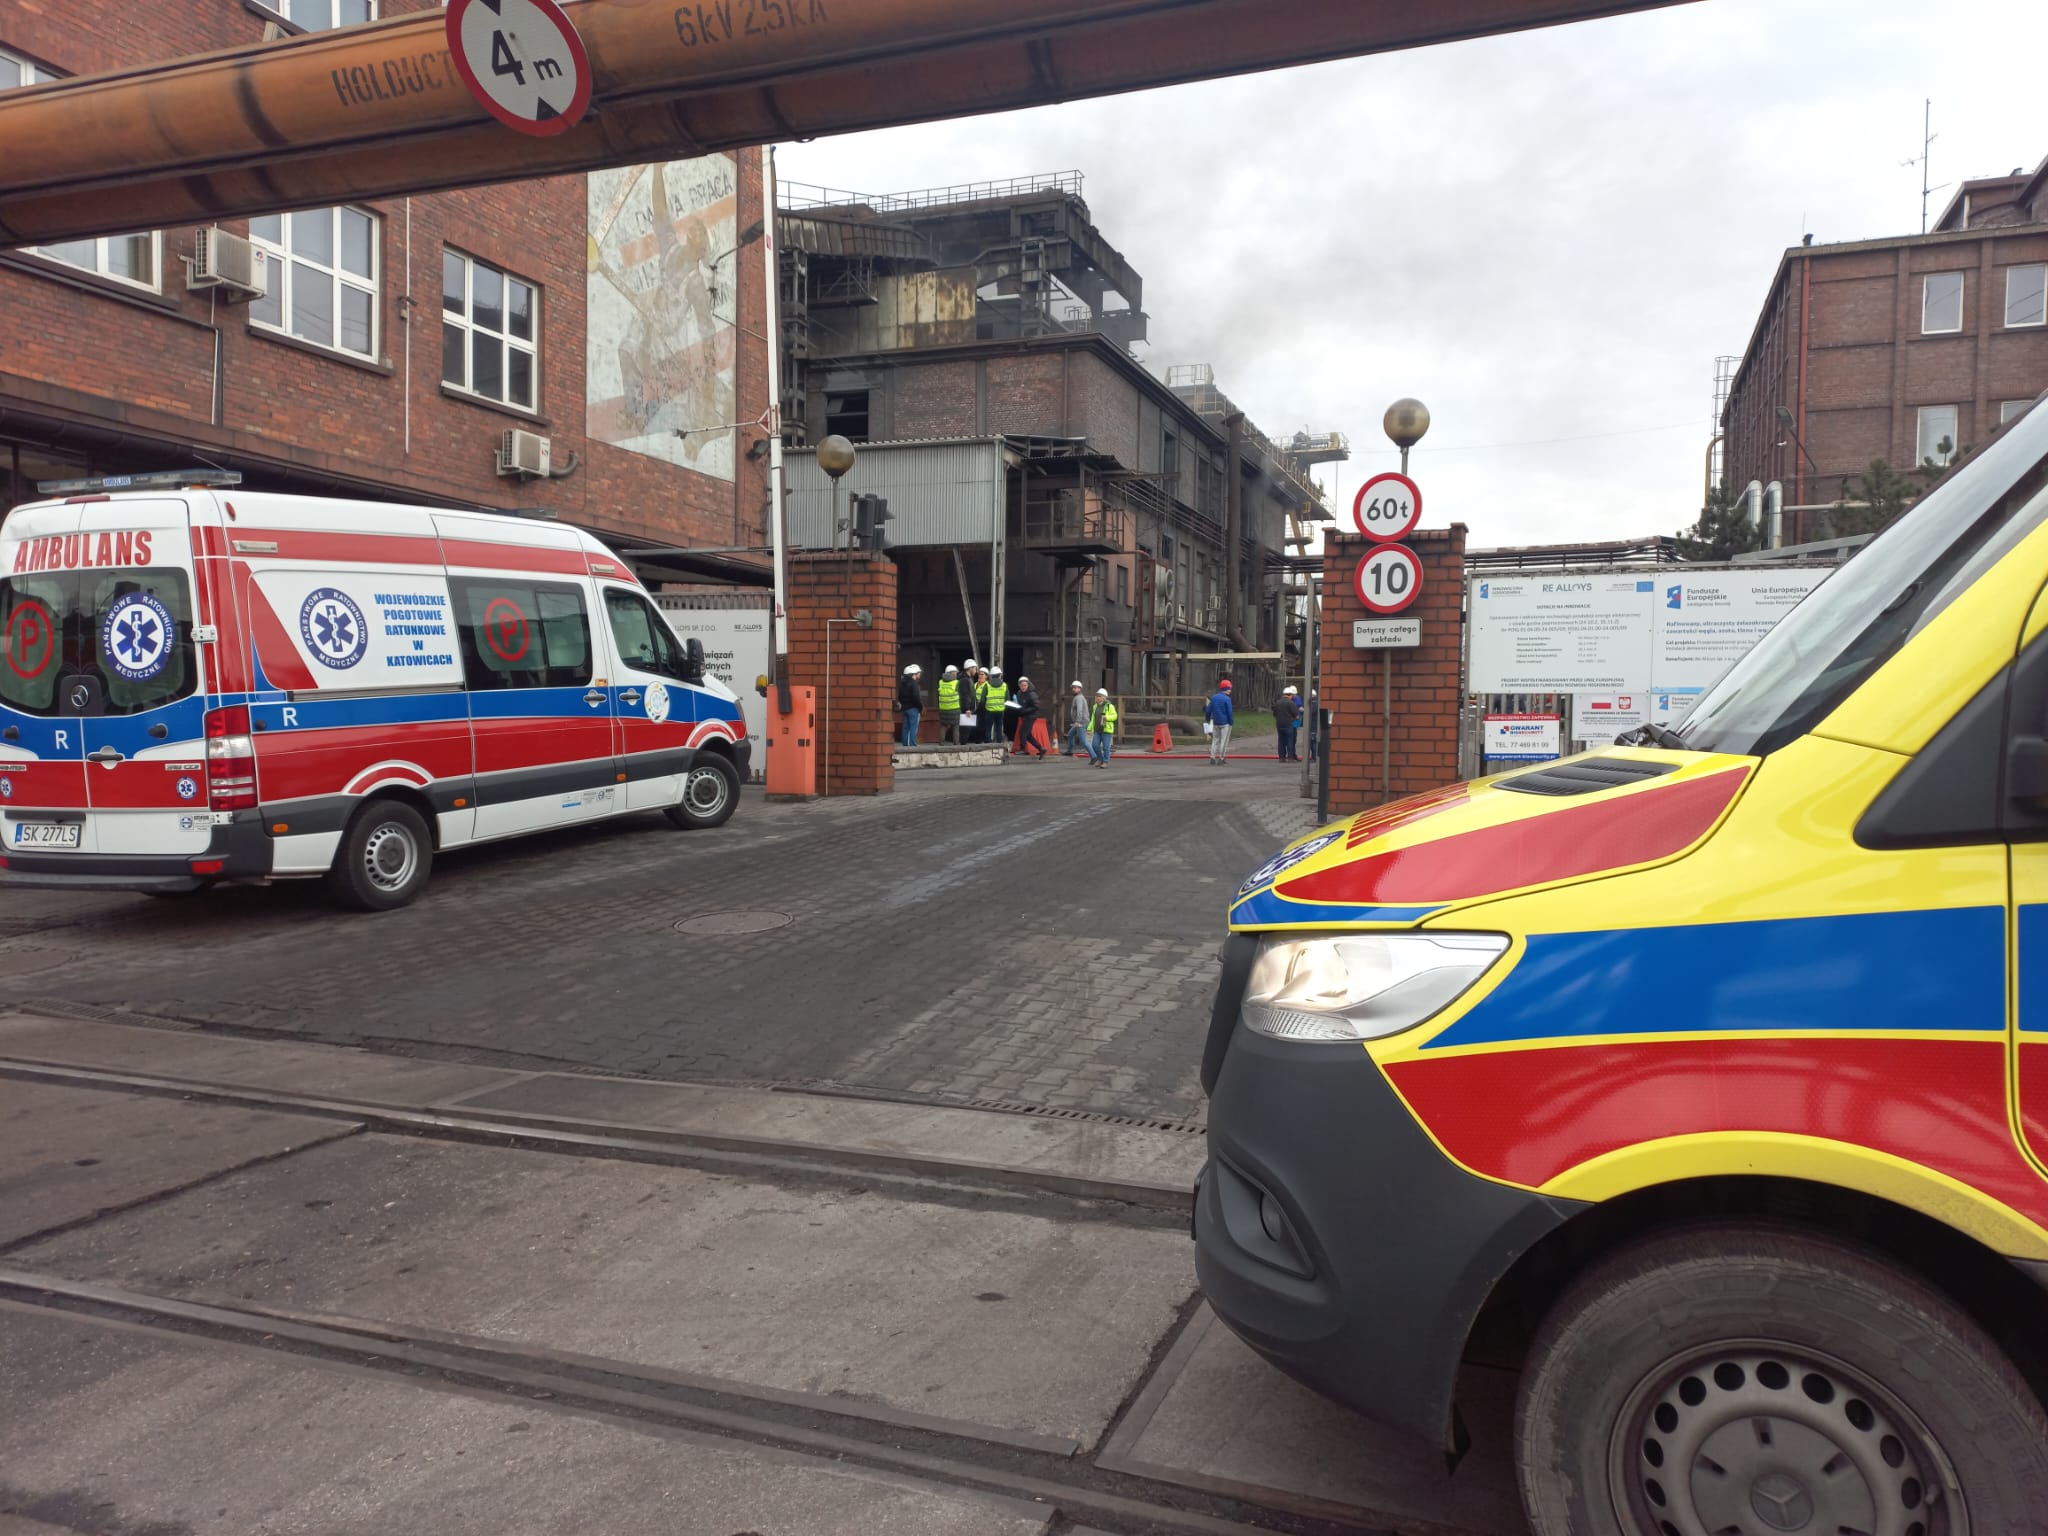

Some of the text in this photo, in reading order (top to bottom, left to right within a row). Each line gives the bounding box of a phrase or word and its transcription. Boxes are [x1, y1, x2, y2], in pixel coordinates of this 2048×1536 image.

[491, 28, 563, 86] 4 m
[331, 50, 456, 106] HOLDUCT
[13, 530, 153, 574] AMBULANS
[1370, 562, 1408, 595] 10
[1542, 583, 1592, 592] RE ALLOYS
[1769, 586, 1808, 595] Europejska
[374, 593, 446, 606] WOJEWÓDZKIE
[383, 609, 443, 621] POGOTOWIE
[301, 591, 367, 668] PAŃSTWOWE RATOWNICTWO MEDYCZNE
[385, 624, 446, 636] RATUNKOWE
[1356, 625, 1417, 635] Dotyczy całego
[105, 595, 173, 679] PAŃSTWOWE RATOWNICTWO MEDYCZNE
[413, 639, 423, 650] W
[386, 654, 453, 667] KATOWICACH
[705, 662, 731, 671] dnych
[282, 707, 298, 726] R
[55, 729, 70, 749] R
[23, 826, 76, 842] SK 277LS
